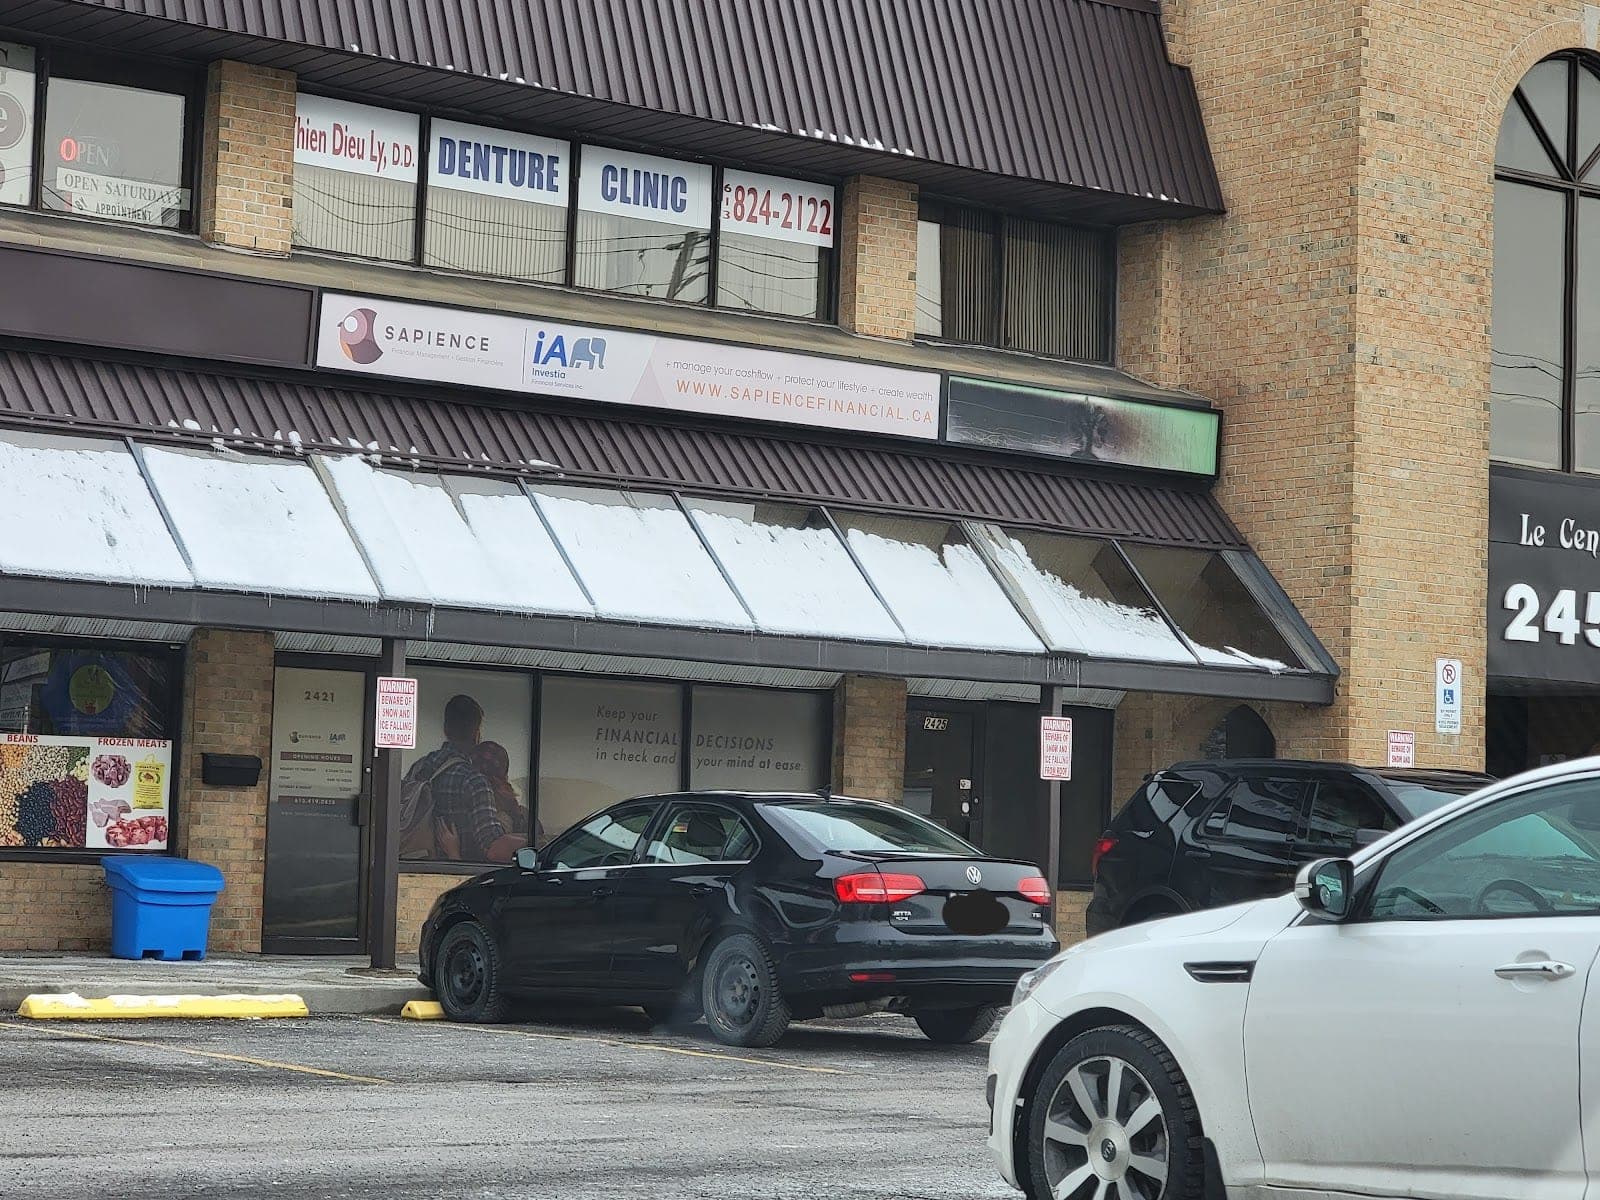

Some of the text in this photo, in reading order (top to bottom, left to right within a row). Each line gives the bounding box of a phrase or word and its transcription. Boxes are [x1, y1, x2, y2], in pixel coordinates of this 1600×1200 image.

[59, 137, 110, 167] OPEN
[294, 116, 415, 172] hien Dieu Ly, D.D.
[64, 174, 98, 191] OPEN
[438, 136, 687, 213] DENTURE CLINIC
[733, 185, 831, 235] 824-2122
[385, 325, 490, 352] SAPIENCE
[532, 367, 566, 379] Investia
[673, 360, 712, 374] manage
[713, 365, 733, 376] your
[735, 368, 774, 380] cashflow
[784, 375, 814, 386] protect
[816, 379, 835, 389] your
[878, 387, 904, 398] create
[906, 390, 933, 401] wealth
[677, 379, 933, 424] WWW.SAPIENCEFINANCIAL.CA
[1520, 513, 1545, 546] Le
[380, 681, 415, 693] WARNING
[304, 691, 335, 703] 2421
[381, 696, 412, 706] BEWARE OF
[382, 708, 411, 719] SNOW AND
[596, 706, 658, 723] Keep your
[389, 721, 412, 731] FALLING
[925, 717, 948, 730] 2425
[1043, 720, 1070, 731] WARNING
[7, 734, 39, 743] BEANS
[98, 738, 167, 748] FROZEN MEATS
[381, 732, 411, 743] FROM ROOF
[596, 728, 775, 751] FINANCIAL DECISIONS
[596, 748, 607, 761] in
[613, 748, 648, 763] check
[653, 752, 677, 764] and
[696, 757, 721, 769] your
[726, 756, 755, 768] mind
[759, 758, 771, 769] at
